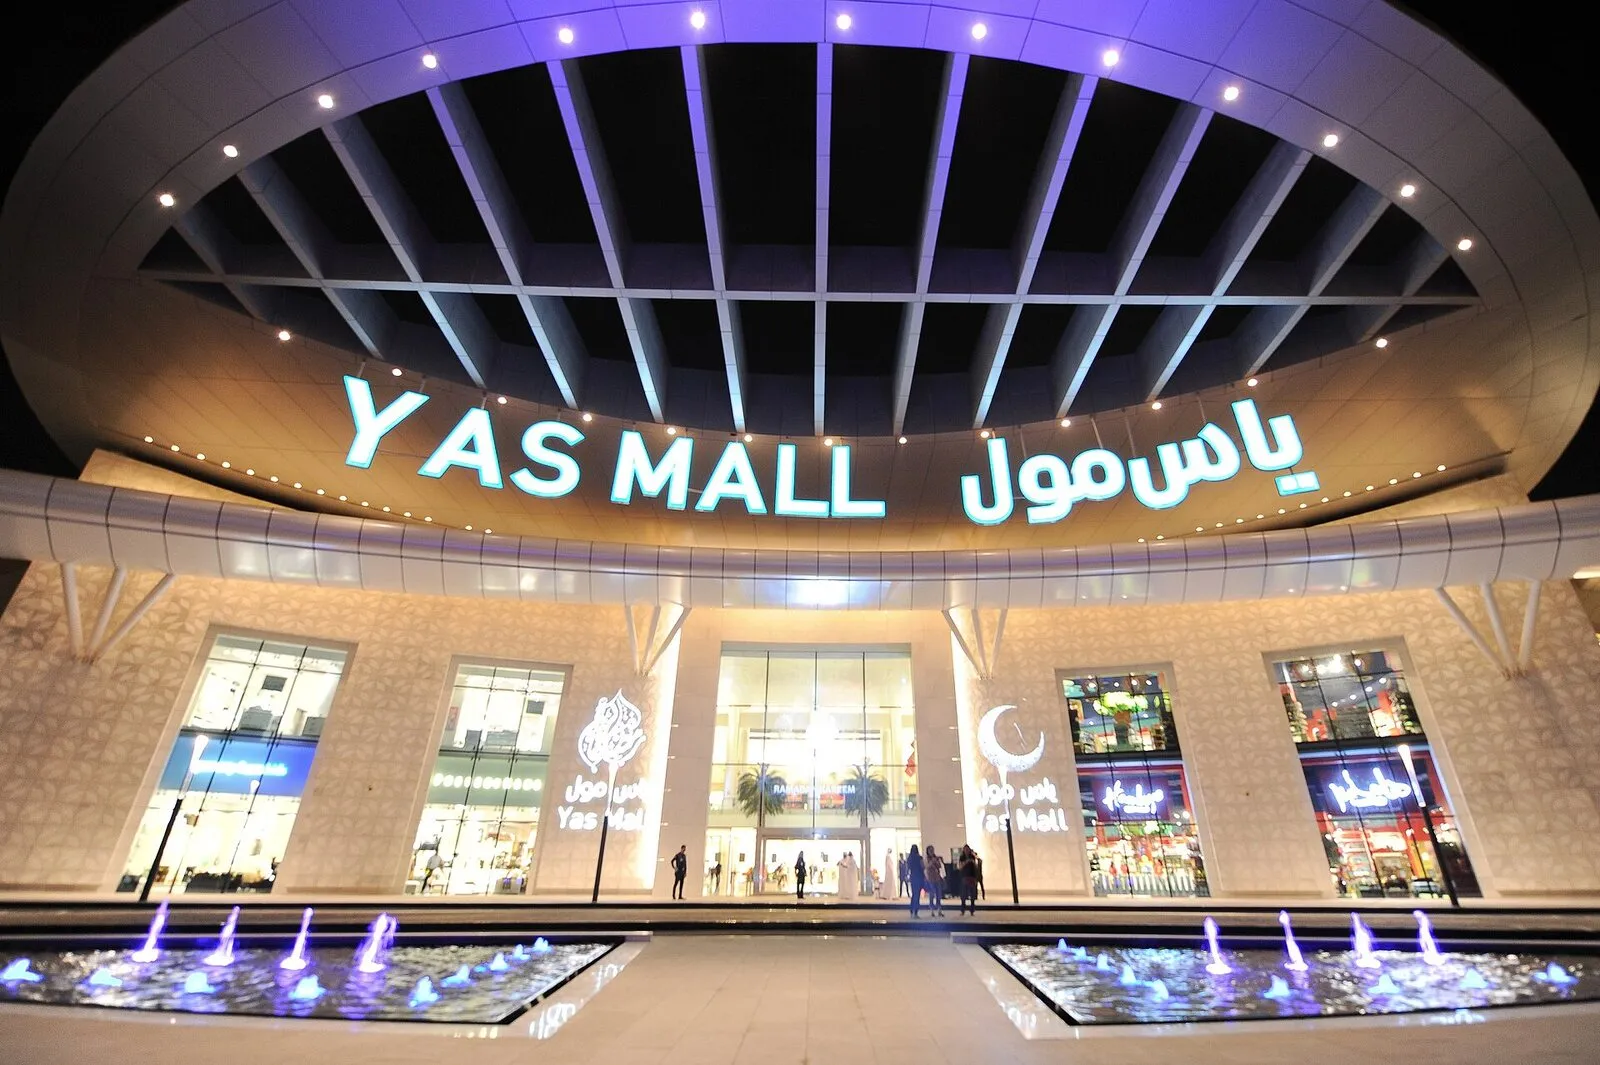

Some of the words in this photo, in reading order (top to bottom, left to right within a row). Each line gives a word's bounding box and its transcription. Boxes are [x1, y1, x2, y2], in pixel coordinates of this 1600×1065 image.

[342, 374, 586, 499] YAS
[609, 429, 887, 518] MALL
[960, 436, 1127, 526] مول
[1126, 397, 1321, 511] ياس
[557, 805, 598, 831] Yas
[607, 806, 653, 831] Mal
[1015, 807, 1069, 833] Mall
